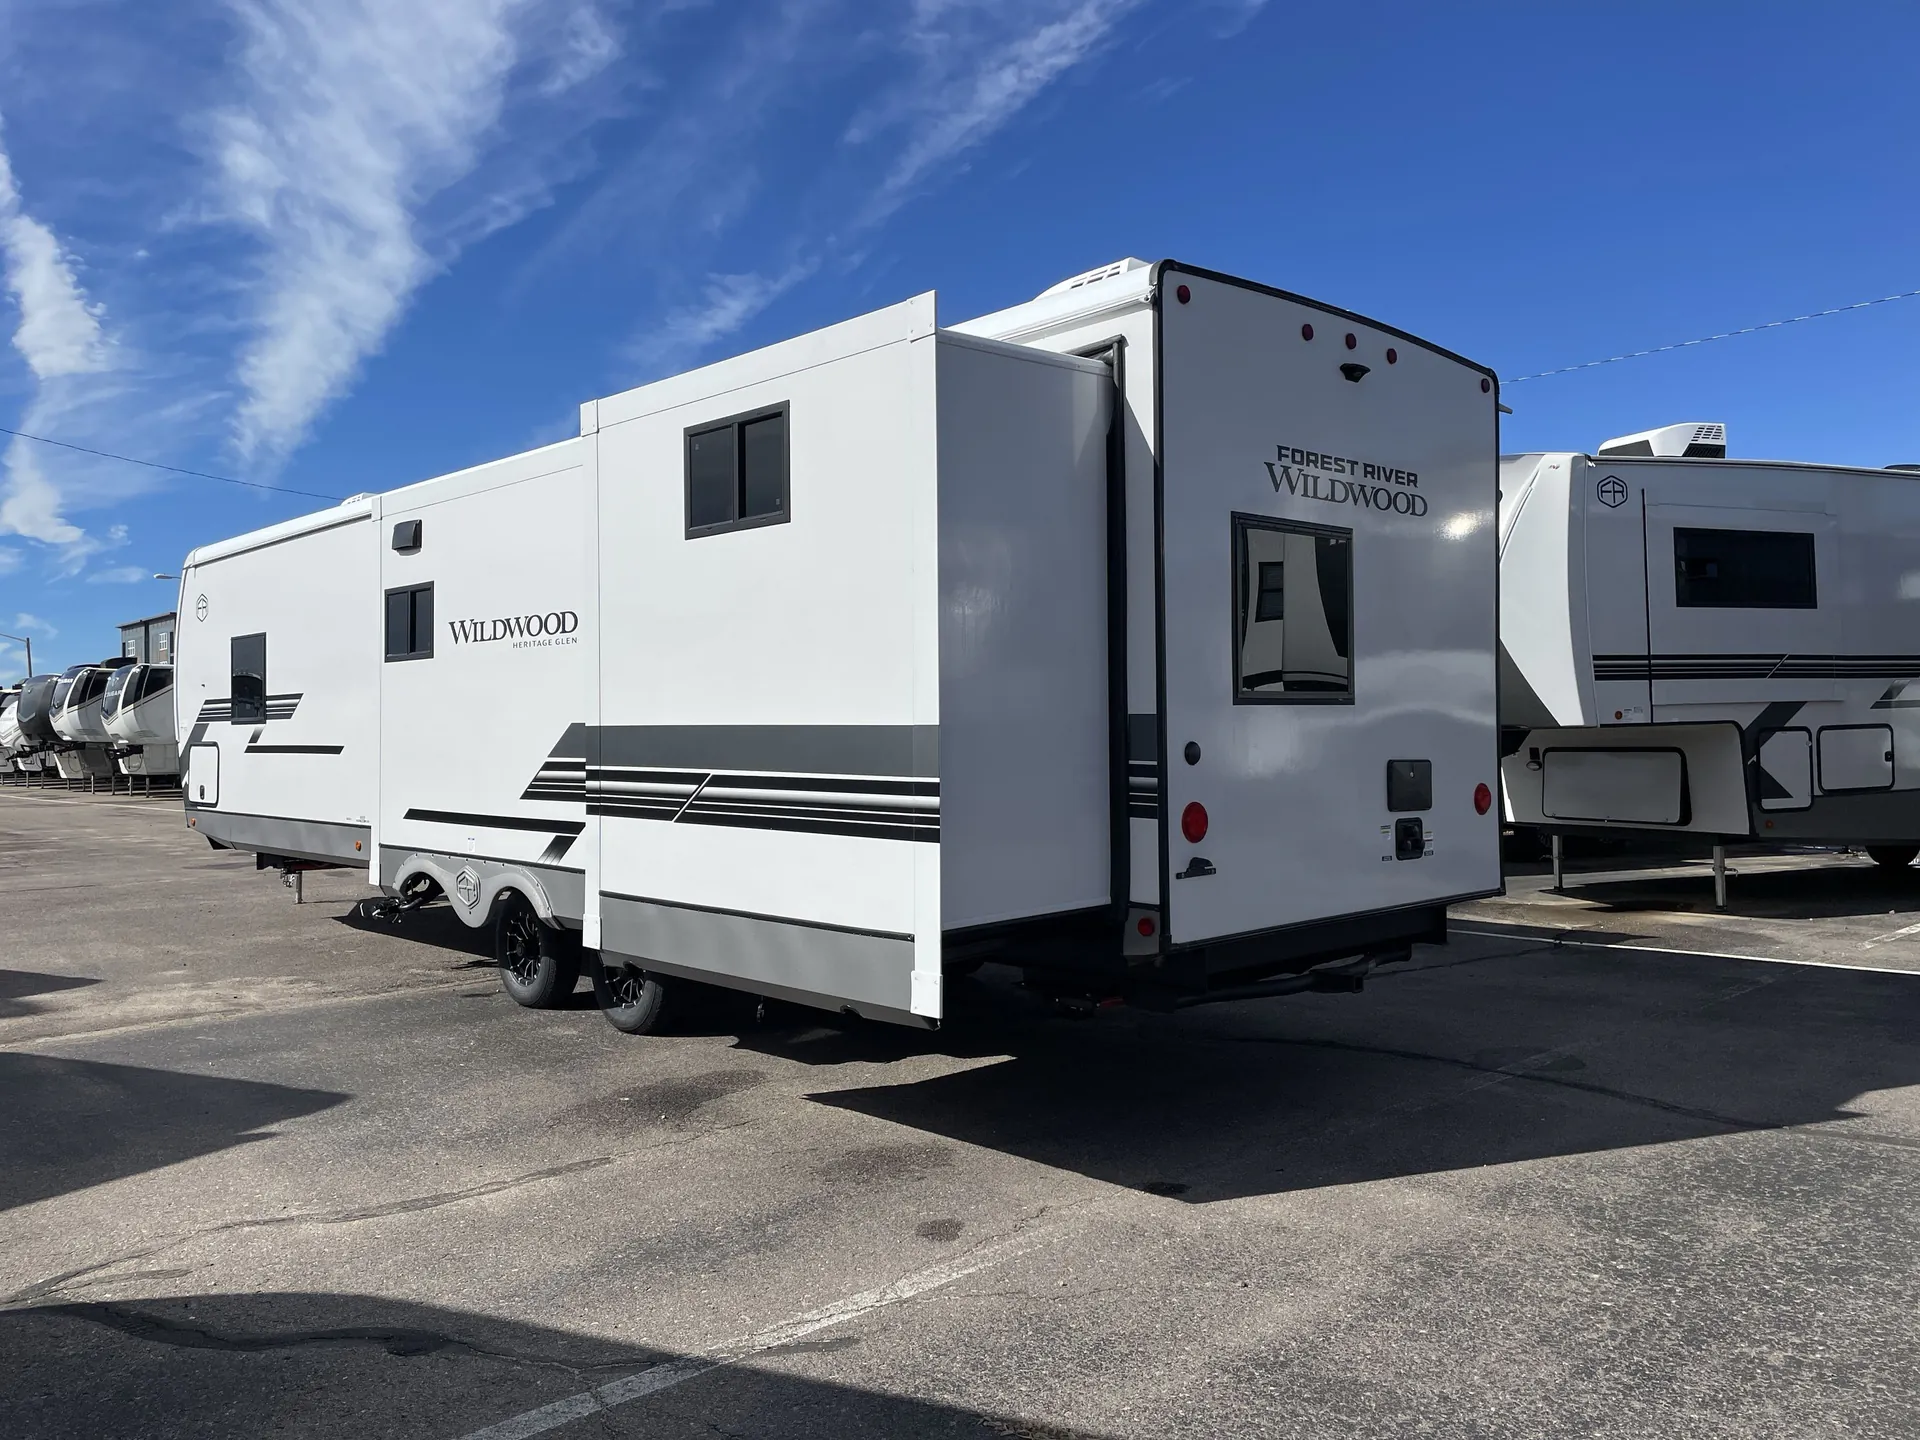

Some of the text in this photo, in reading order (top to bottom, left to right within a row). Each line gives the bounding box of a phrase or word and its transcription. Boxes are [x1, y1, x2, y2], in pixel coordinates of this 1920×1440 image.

[1276, 445, 1418, 488] FOREST RIVER
[1264, 461, 1428, 517] WILDWOOD
[448, 610, 579, 645] WILDWOOD
[512, 637, 578, 649] HERITAGE GLEN
